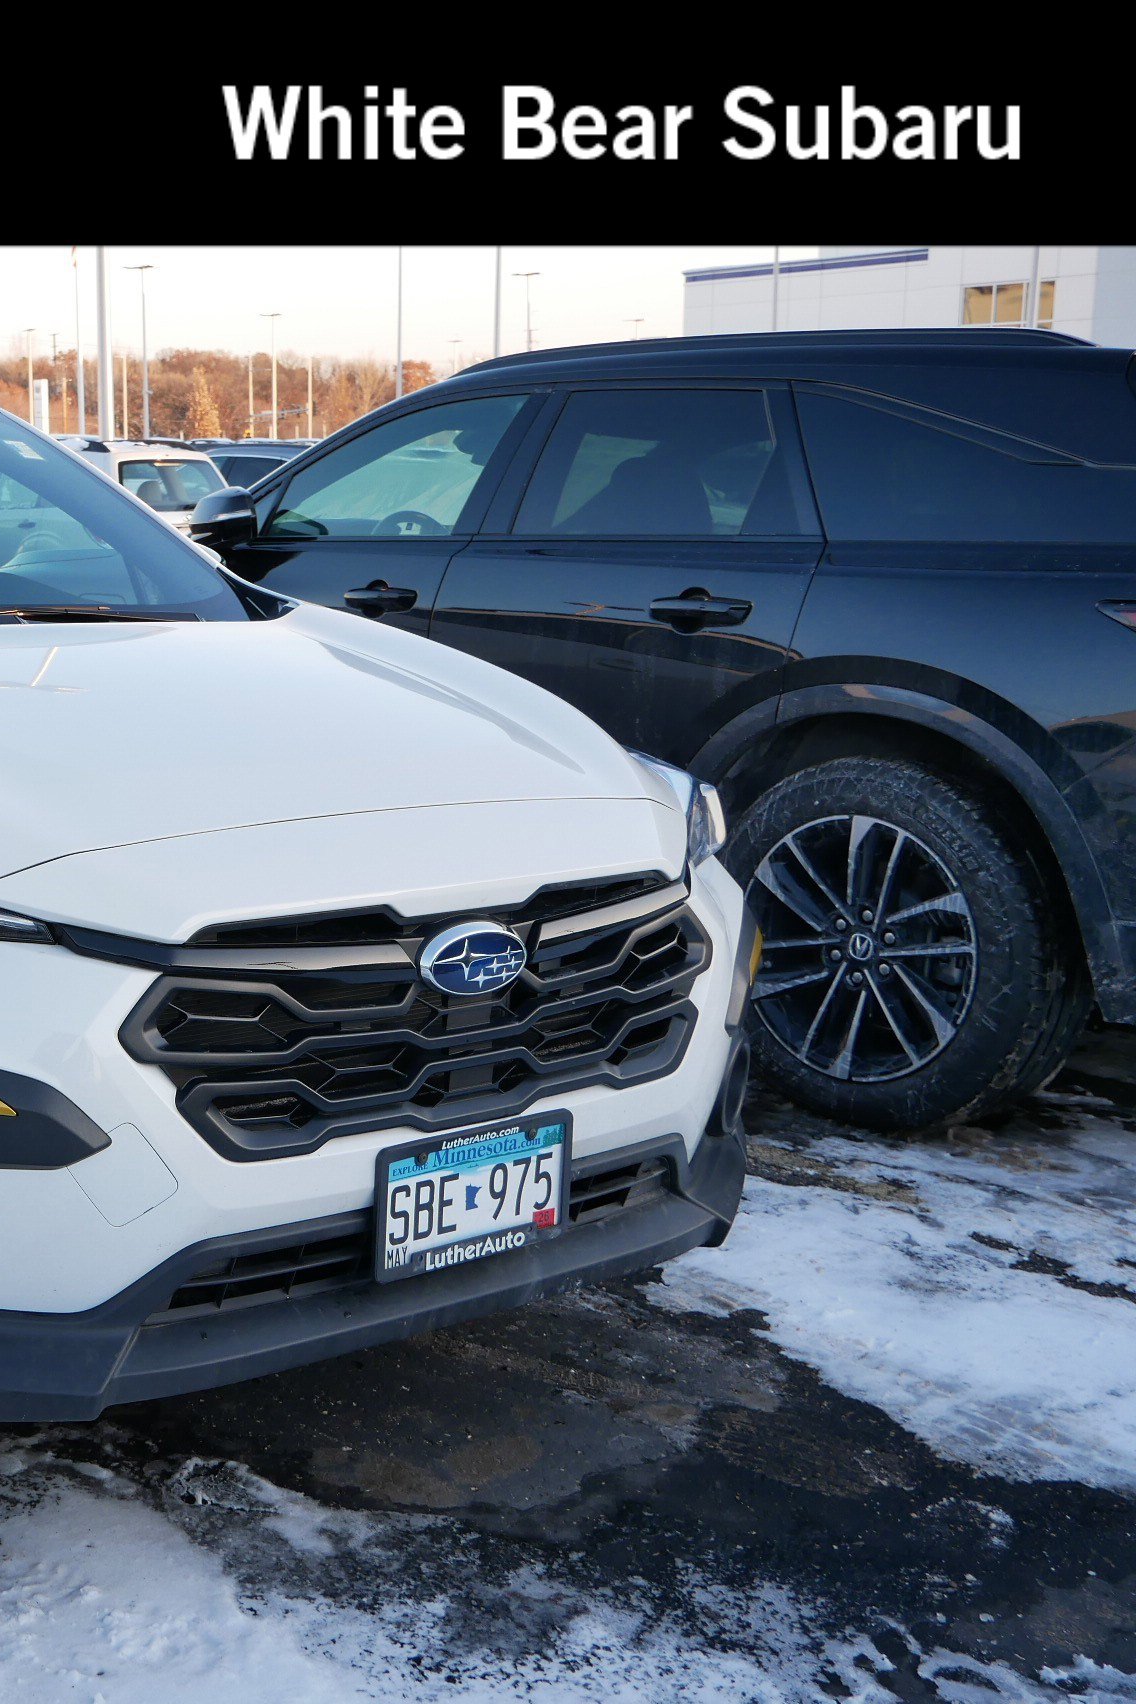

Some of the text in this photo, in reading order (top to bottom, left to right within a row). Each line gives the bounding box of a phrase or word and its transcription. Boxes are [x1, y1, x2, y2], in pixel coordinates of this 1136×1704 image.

[441, 1126, 520, 1150] LutherAuto.com
[388, 1151, 554, 1246] SBE 975
[387, 1246, 408, 1269] MAY
[425, 1230, 526, 1270] LutherAuto
